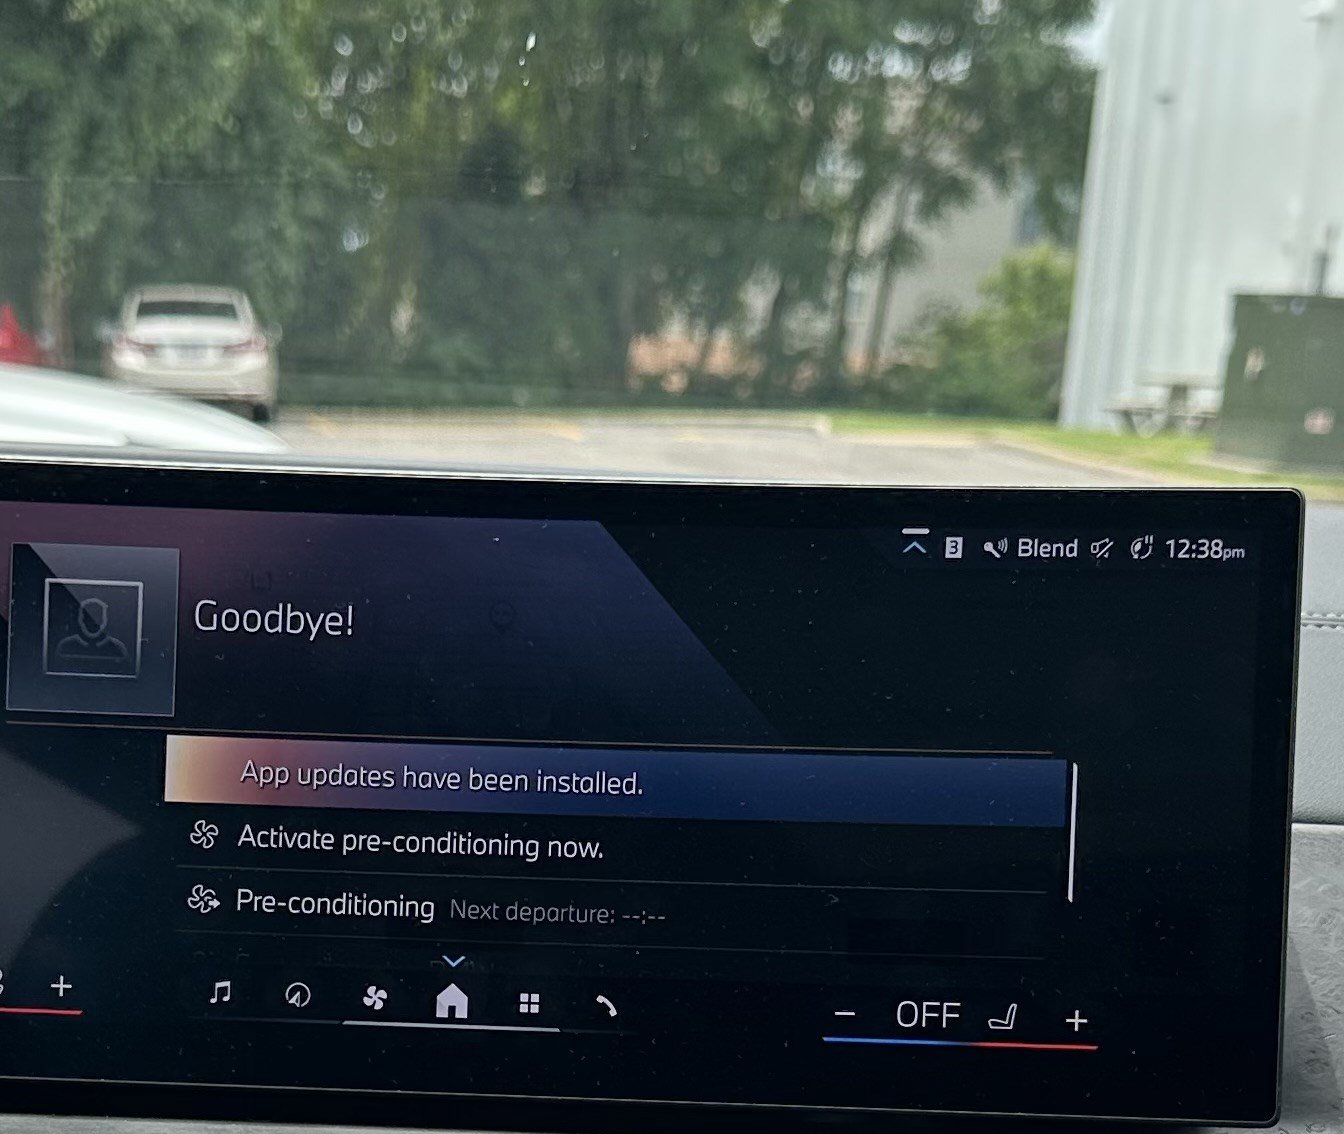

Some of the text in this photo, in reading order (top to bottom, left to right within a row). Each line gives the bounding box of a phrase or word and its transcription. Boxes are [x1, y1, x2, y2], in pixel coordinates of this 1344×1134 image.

[1017, 538, 1078, 558] Blend
[1164, 538, 1246, 561] 12:38pm
[194, 599, 354, 641] Goodbye!
[240, 759, 643, 796] App updates have been installed.
[237, 824, 603, 862] Activate pre-conditioning now.
[236, 889, 435, 923] Pre-conditioning
[450, 899, 500, 921] Next
[505, 902, 616, 926] departure:
[896, 1000, 961, 1028] OFF
